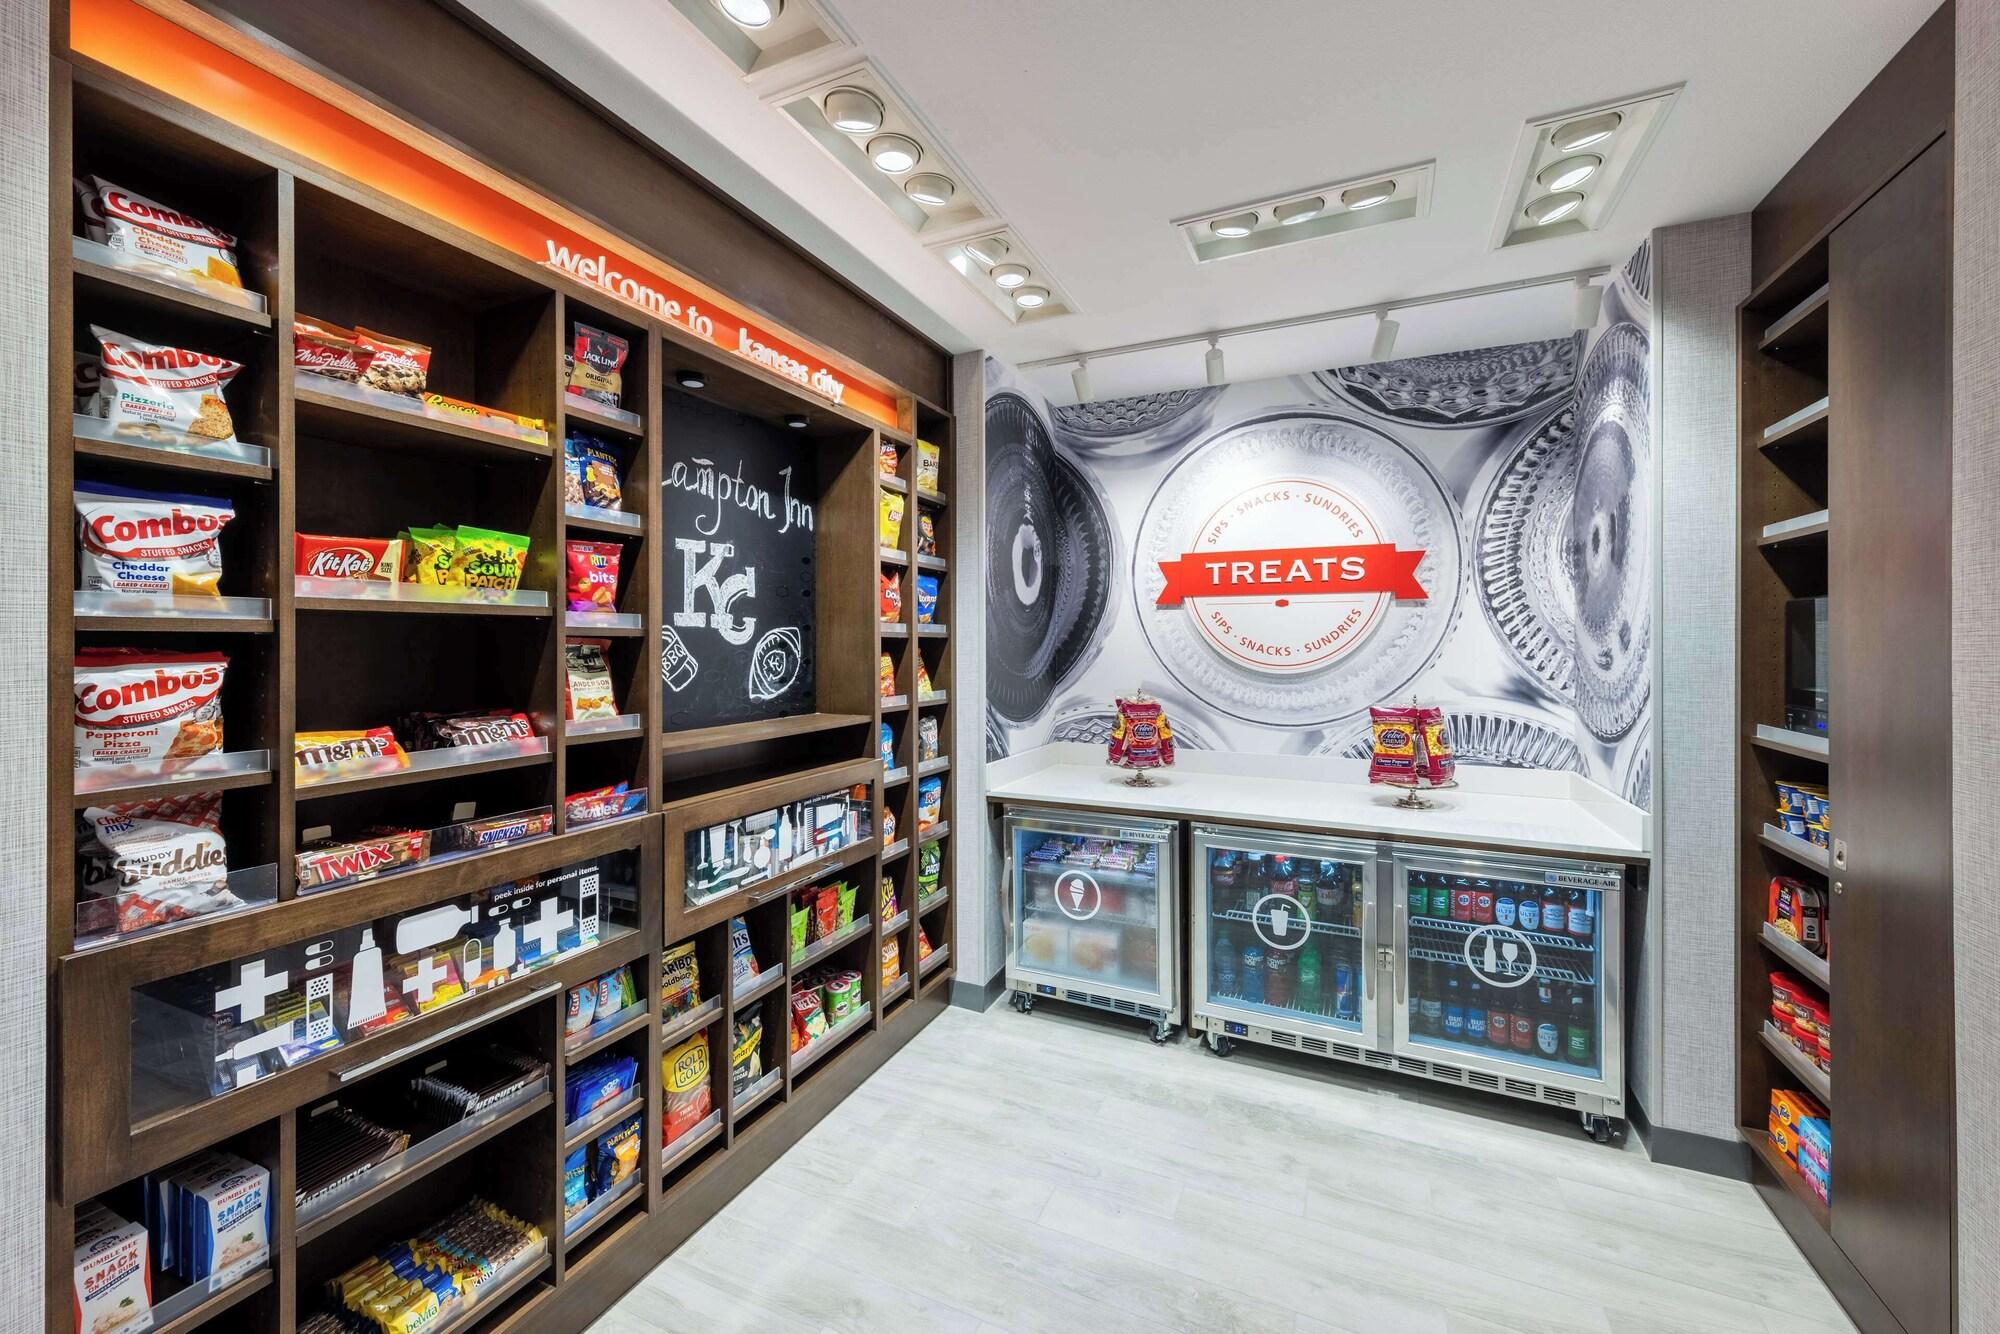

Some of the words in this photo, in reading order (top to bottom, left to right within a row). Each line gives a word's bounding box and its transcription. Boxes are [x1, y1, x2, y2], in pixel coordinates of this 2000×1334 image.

[546, 239, 682, 318] welcome
[686, 305, 713, 338] to
[738, 327, 809, 384] kansas
[811, 367, 844, 404] city
[582, 351, 601, 365] JACK
[184, 374, 216, 388] SNACKS
[585, 372, 613, 385] ORIGINAL
[91, 508, 233, 544] Combos
[1207, 519, 1229, 545] SIPS
[1236, 490, 1290, 515] SNACKS
[1303, 492, 1364, 539] SUNDRIES
[140, 547, 176, 558] STUFFED
[177, 541, 210, 555] SNACKS
[112, 561, 171, 573] Cheddar
[117, 571, 167, 582] Cheese
[468, 561, 516, 578] SOUR
[588, 570, 616, 584] bits
[1205, 556, 1366, 585] TREATS
[464, 573, 517, 591] PATCH
[1211, 611, 1233, 635] SIPS
[1239, 636, 1291, 657] SNACKS
[1303, 607, 1362, 654] SUNDRIES
[77, 667, 220, 715] Combos
[122, 711, 161, 725] STUFFED
[163, 700, 197, 717] SNACKS
[85, 728, 160, 742] Pepperoni
[103, 739, 141, 748] Pizza
[97, 814, 132, 826] Chex
[104, 821, 135, 835] mix
[480, 824, 527, 844] SNICKERS
[131, 850, 172, 865] MUDDY
[308, 843, 394, 883] TWIX
[494, 890, 513, 902] peek
[513, 883, 534, 896] inside
[535, 880, 547, 889] for
[546, 870, 578, 887] personal
[578, 865, 599, 876] items.
[678, 1048, 703, 1071] ROLD
[679, 1060, 705, 1084] GOLD
[606, 1121, 640, 1149] PLANTERS
[217, 1187, 247, 1206] BUMBLE
[217, 1189, 262, 1222] SNACK
[83, 1248, 121, 1272] BUMBLE
[121, 1239, 137, 1252] BEE
[84, 1248, 139, 1290] SNACK
[405, 1305, 438, 1334] belVita
